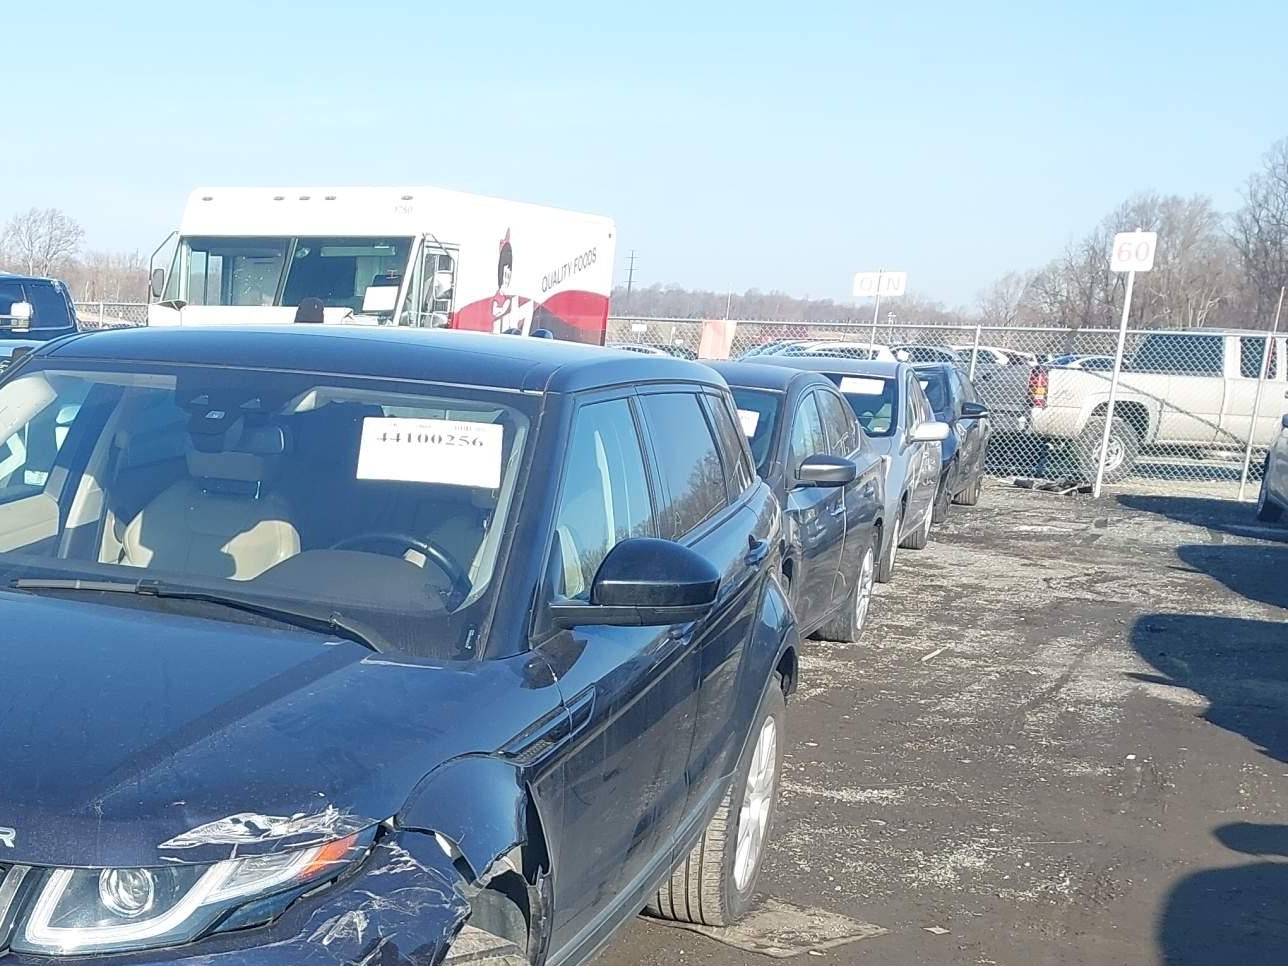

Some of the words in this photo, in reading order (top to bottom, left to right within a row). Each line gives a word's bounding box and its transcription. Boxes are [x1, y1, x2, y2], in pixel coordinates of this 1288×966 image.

[1117, 241, 1150, 262] 60
[541, 262, 573, 293] QUALITY
[574, 247, 597, 274] FOODS
[376, 432, 484, 447] 44100256
